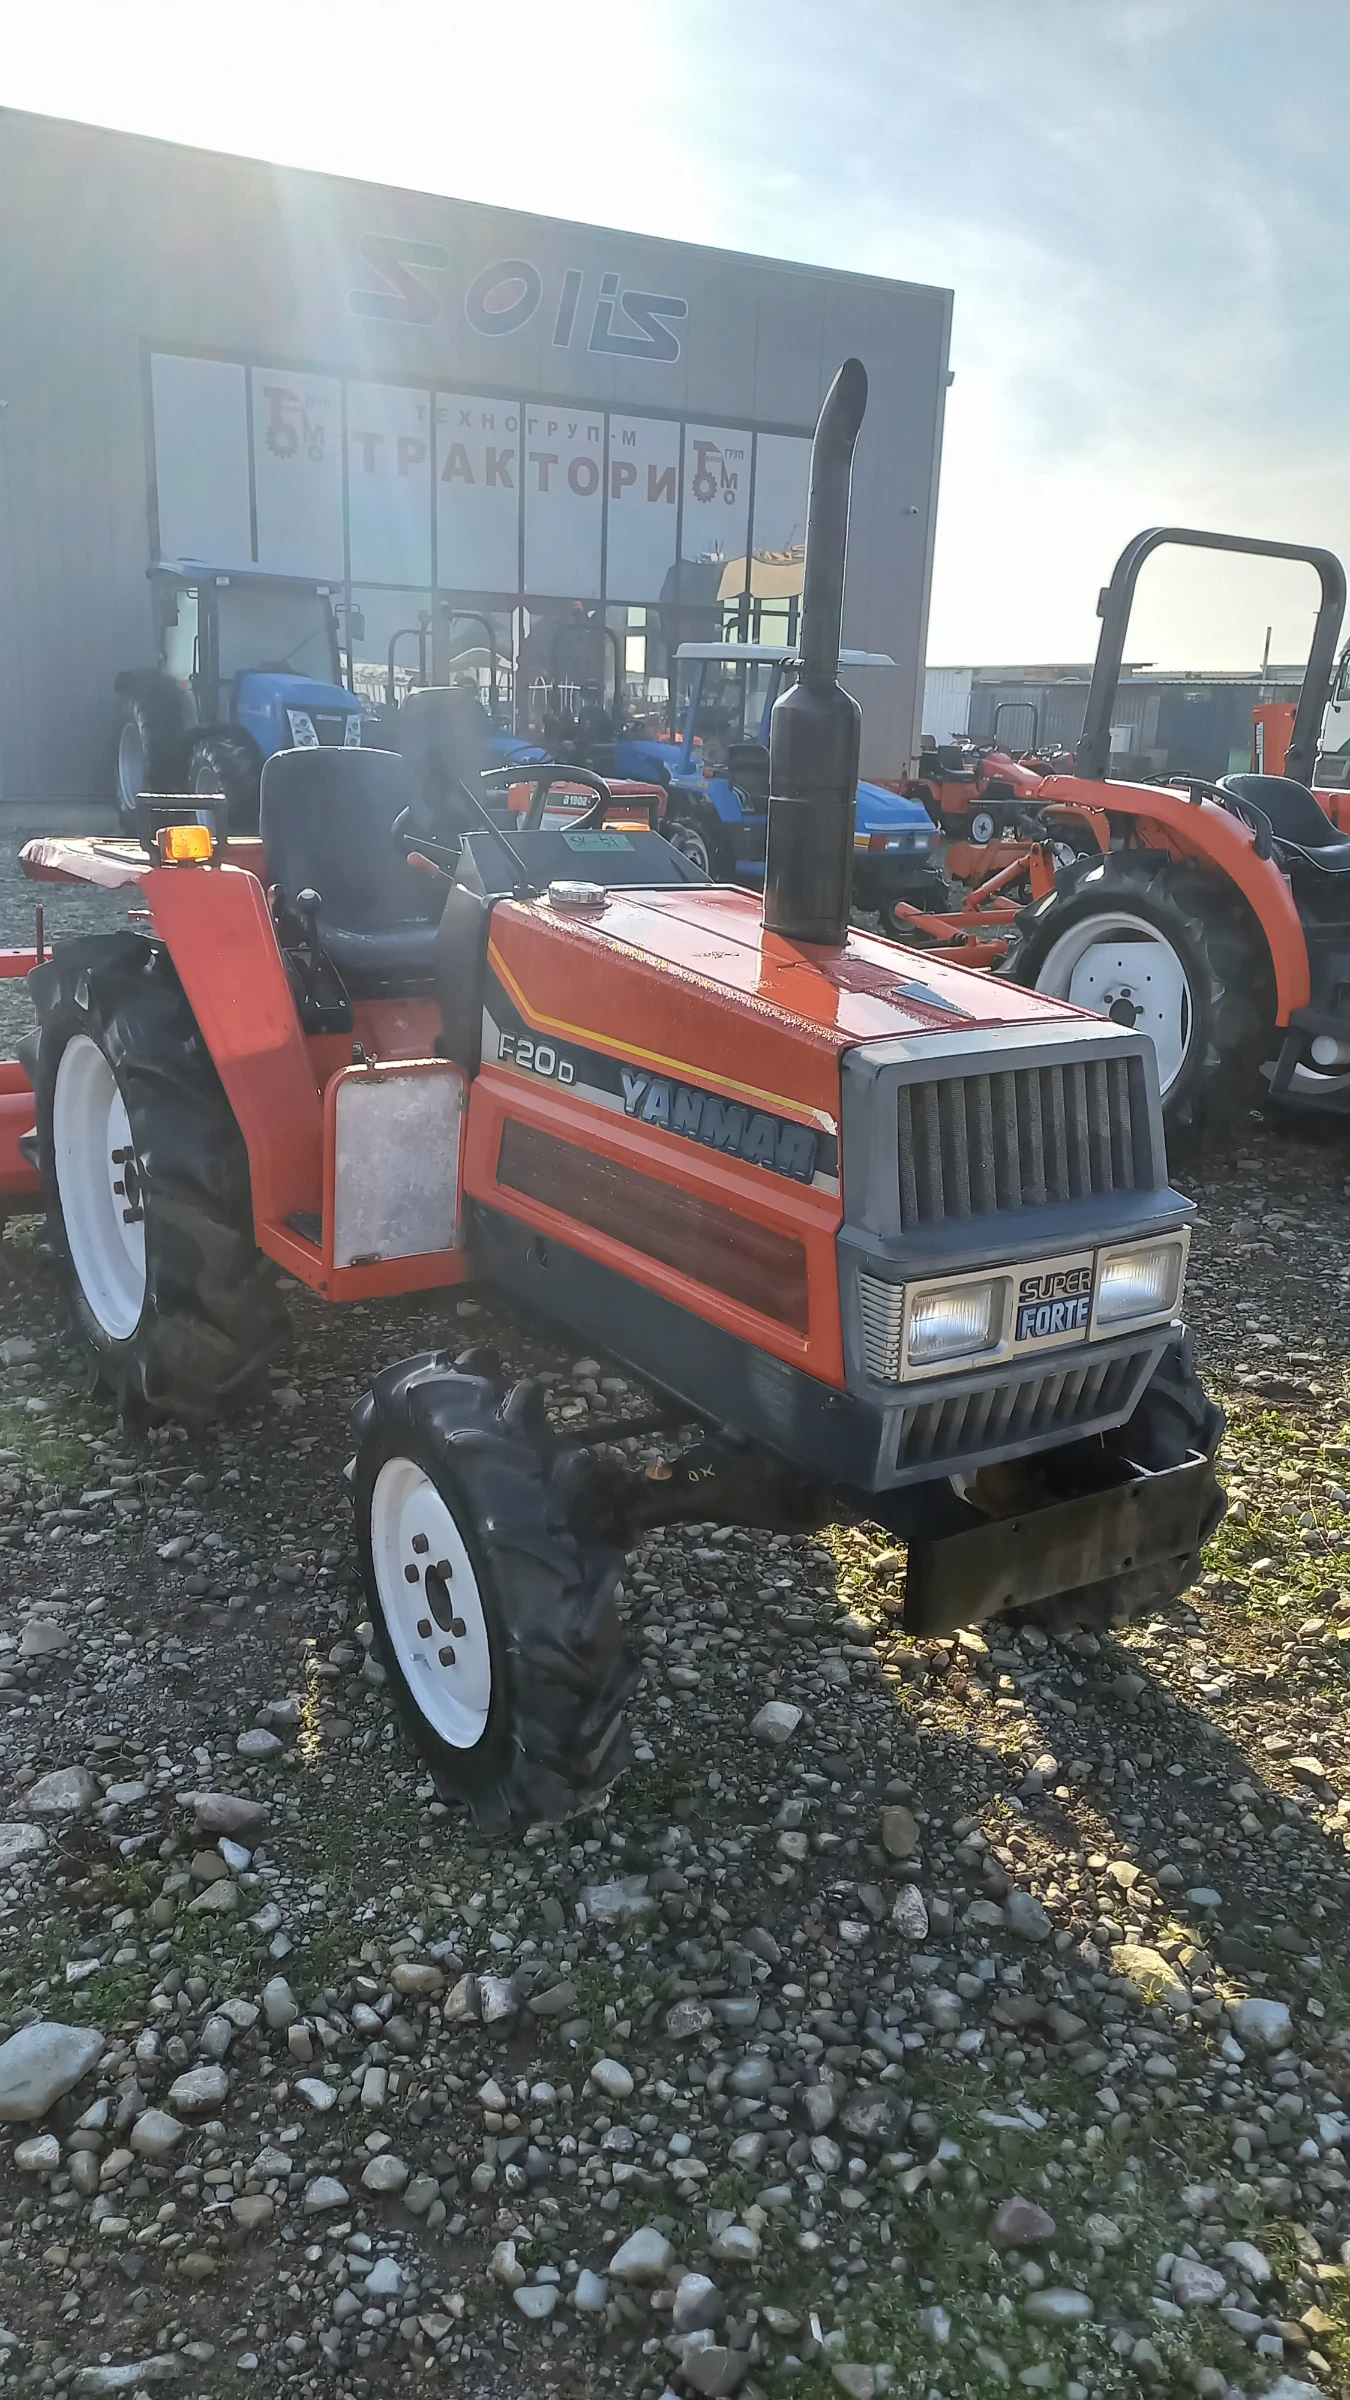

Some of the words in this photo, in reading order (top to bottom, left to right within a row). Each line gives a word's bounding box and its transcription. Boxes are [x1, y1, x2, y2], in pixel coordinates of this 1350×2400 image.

[348, 232, 689, 364] Solis
[414, 403, 638, 447] ТЕХНОГРУП-М
[351, 430, 677, 505] ТРАКТОРИ
[620, 1068, 817, 1184] YANMAR
[1019, 1267, 1093, 1303] SUPER
[1016, 1296, 1091, 1341] FORTE
